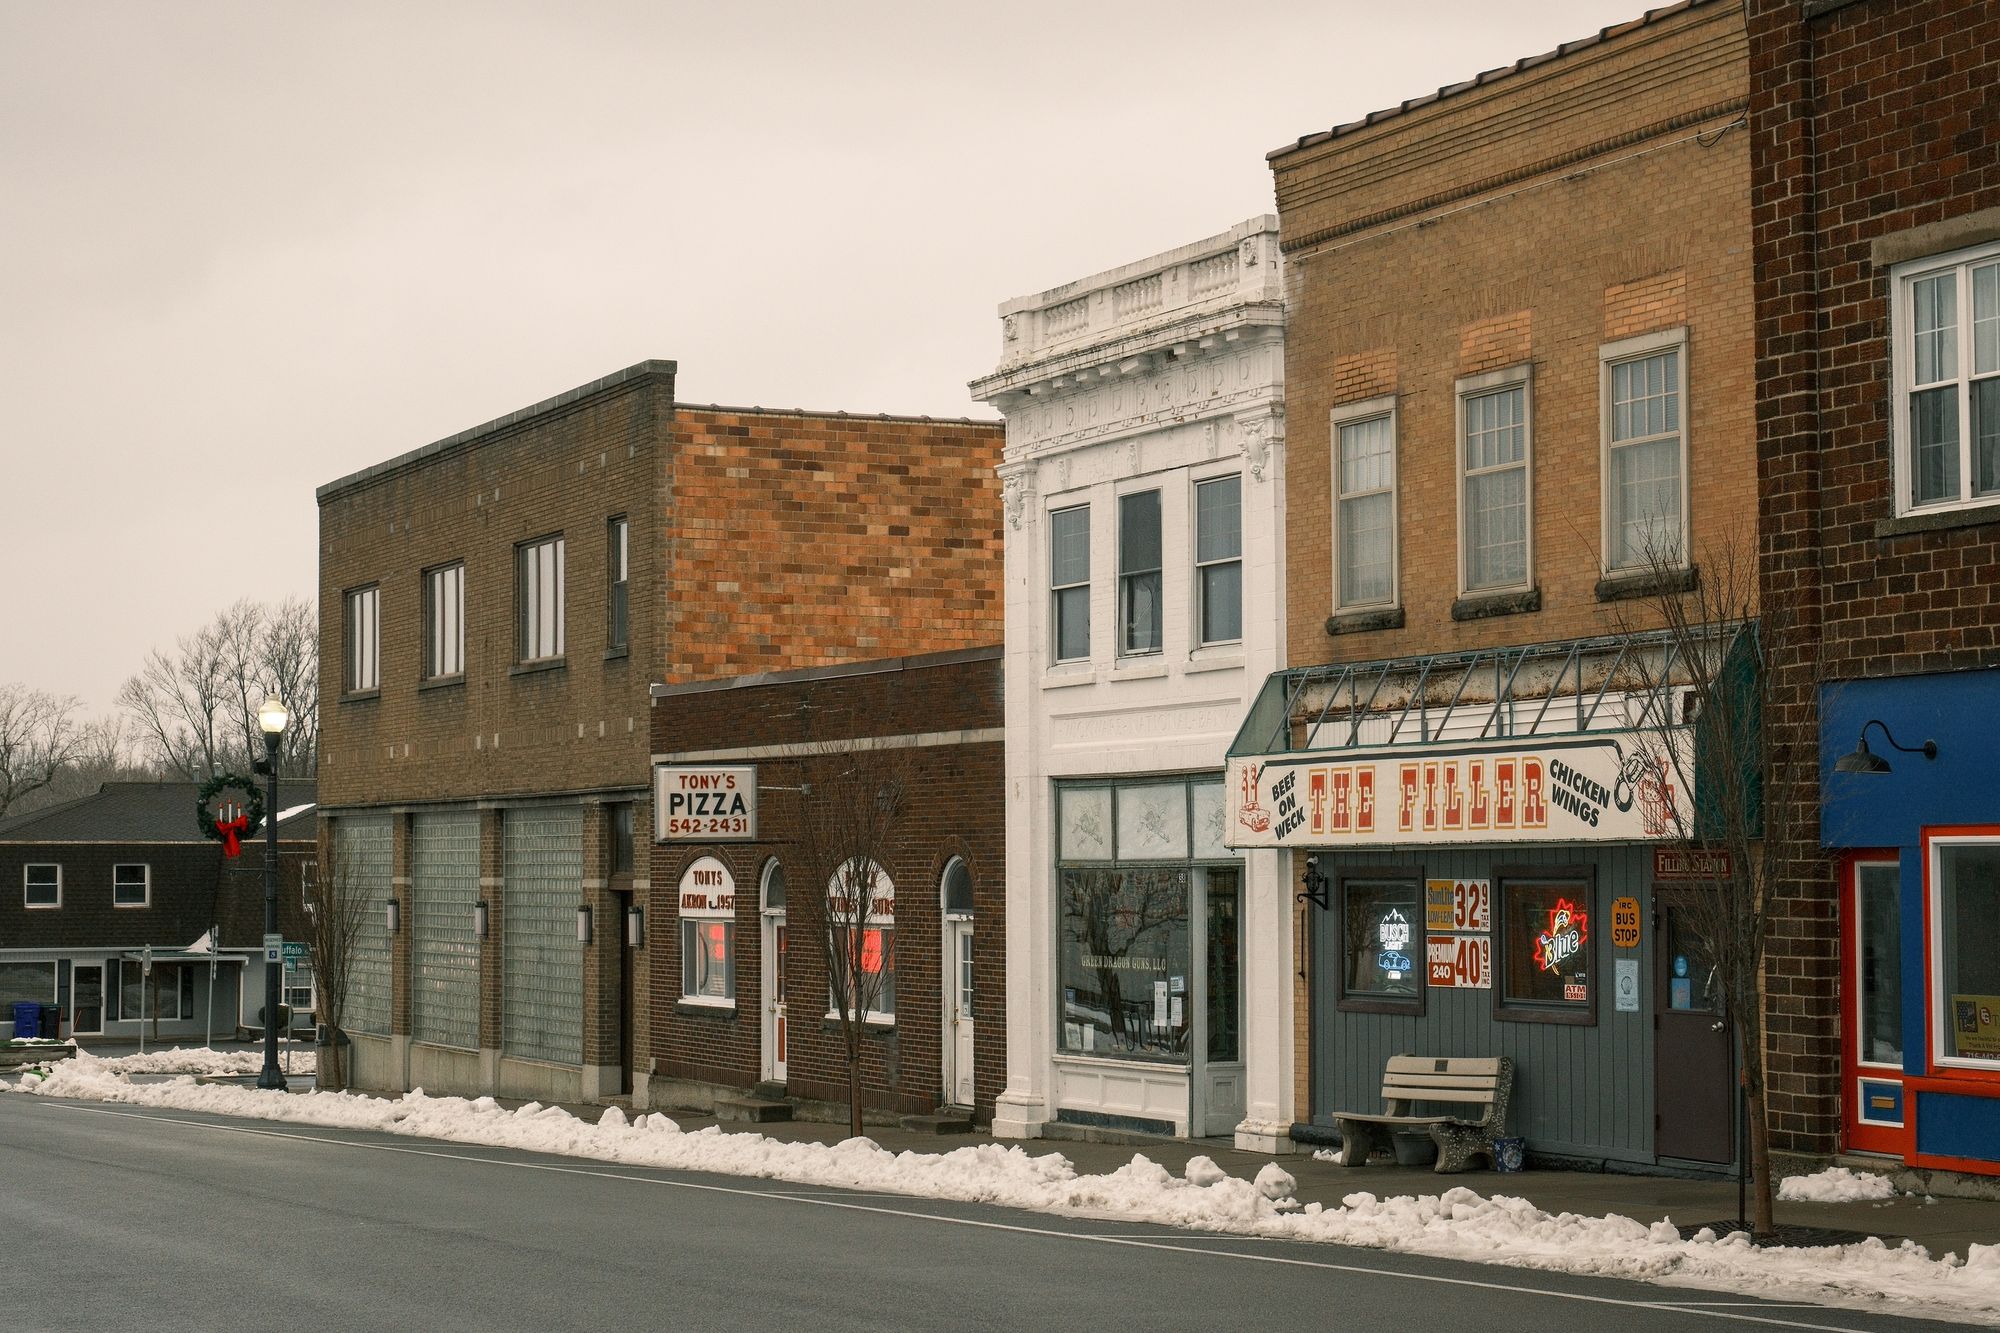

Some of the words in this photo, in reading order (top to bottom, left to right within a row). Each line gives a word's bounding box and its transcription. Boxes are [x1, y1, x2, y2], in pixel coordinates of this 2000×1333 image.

[679, 773, 736, 789] TONY'S
[1271, 770, 1296, 802] BEEF
[1549, 758, 1611, 810] CHICKEN
[670, 793, 747, 815] PIZZA
[1278, 792, 1296, 817] ON
[1309, 765, 1376, 835] THE
[1398, 756, 1548, 833] FILLER
[1551, 783, 1600, 828] WINGS
[669, 818, 747, 833] 542-2431
[1274, 806, 1306, 841] WECK
[692, 870, 723, 886] TONYS
[681, 893, 707, 909] AKRON
[717, 895, 737, 910] 1957
[872, 897, 897, 915] SUBS
[1455, 883, 1480, 928] 32
[1482, 883, 1488, 906] 9
[1616, 912, 1636, 926] BUS
[1379, 923, 1410, 943] BUSCH
[1614, 928, 1638, 942] STOP
[282, 945, 302, 955] uffalo
[1543, 930, 1579, 969] Blue
[1081, 955, 1103, 967] GREEN
[1103, 956, 1130, 969] DRAGON
[1131, 959, 1152, 972] GUNS,
[1152, 959, 1166, 971] LLC
[1428, 943, 1455, 963] PREMIUM
[1456, 940, 1480, 984] 40
[1483, 940, 1489, 963] 9
[1432, 965, 1451, 979] 240
[1565, 985, 1586, 993] ATM
